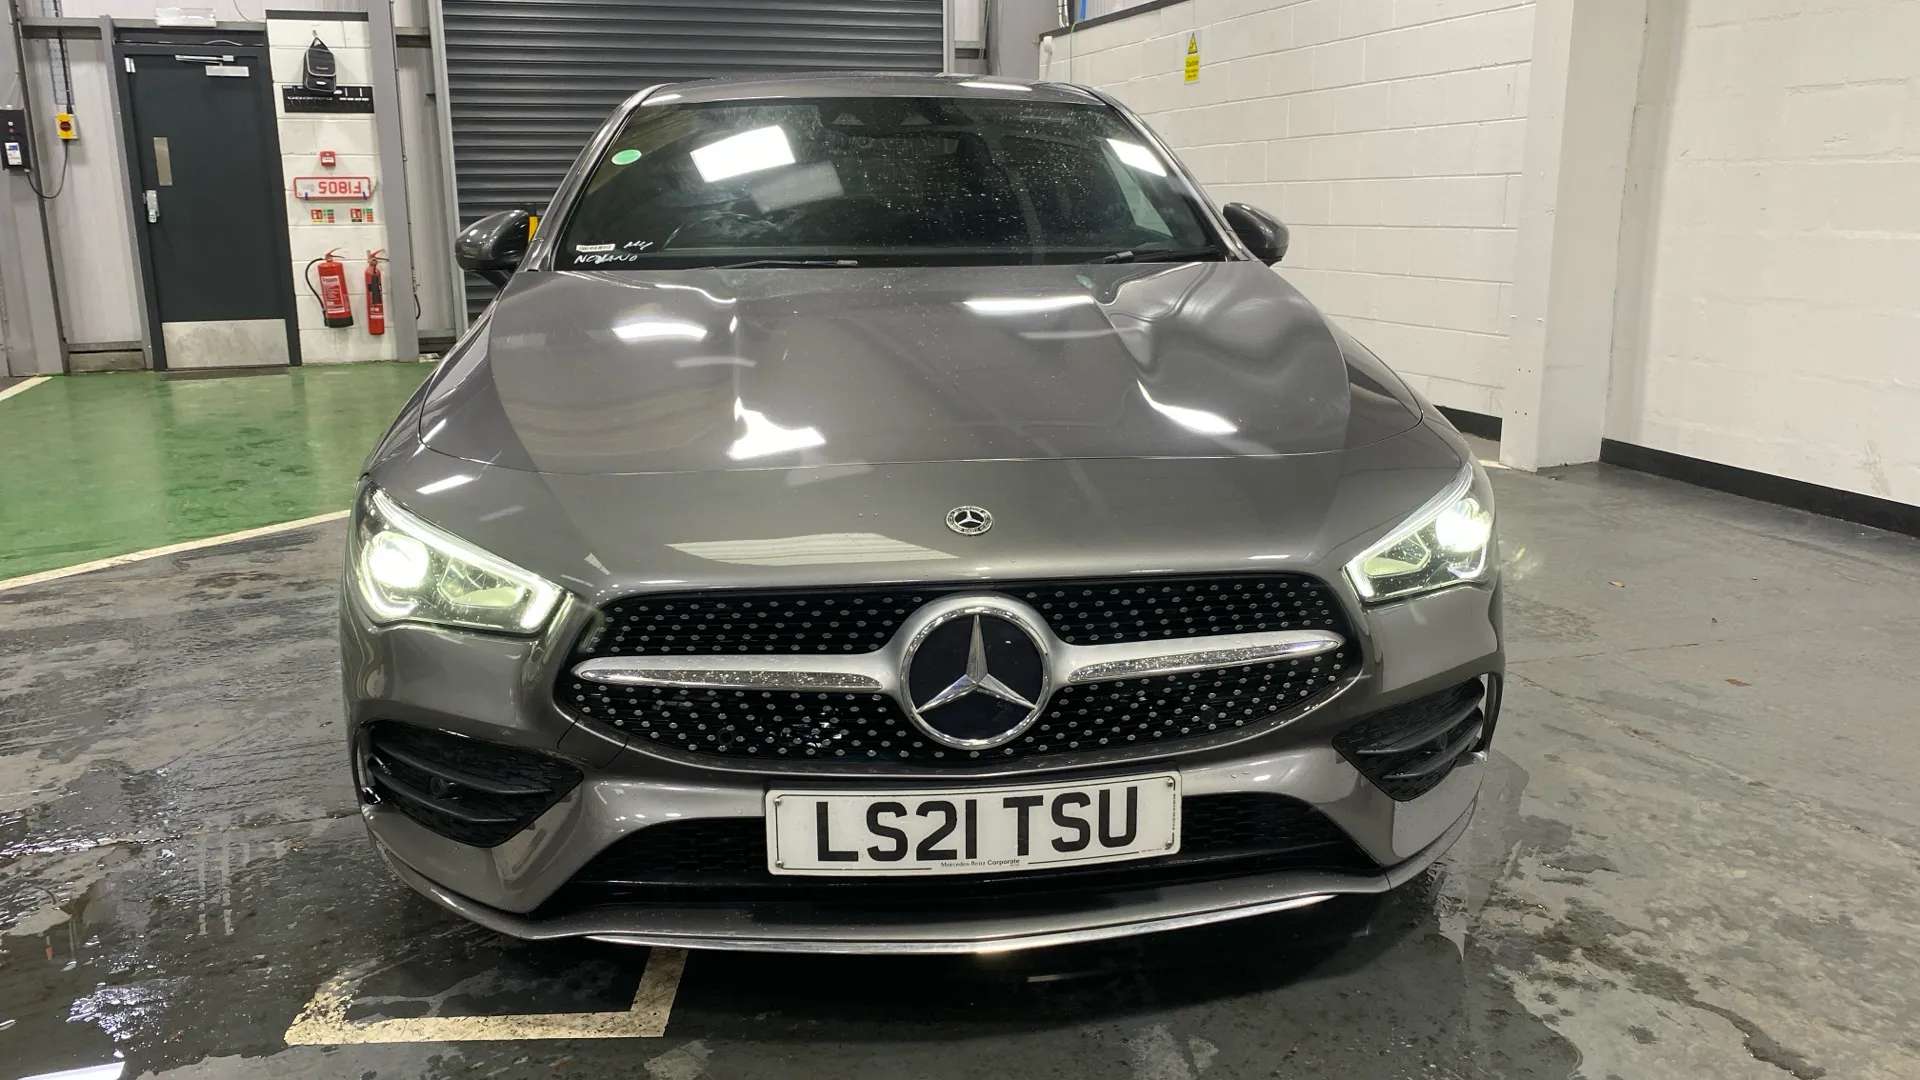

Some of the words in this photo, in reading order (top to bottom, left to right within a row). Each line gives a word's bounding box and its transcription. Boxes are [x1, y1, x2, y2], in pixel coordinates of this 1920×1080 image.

[815, 799, 978, 862] LS21
[1003, 786, 1138, 854] TSU
[987, 858, 1020, 867] Corporate
